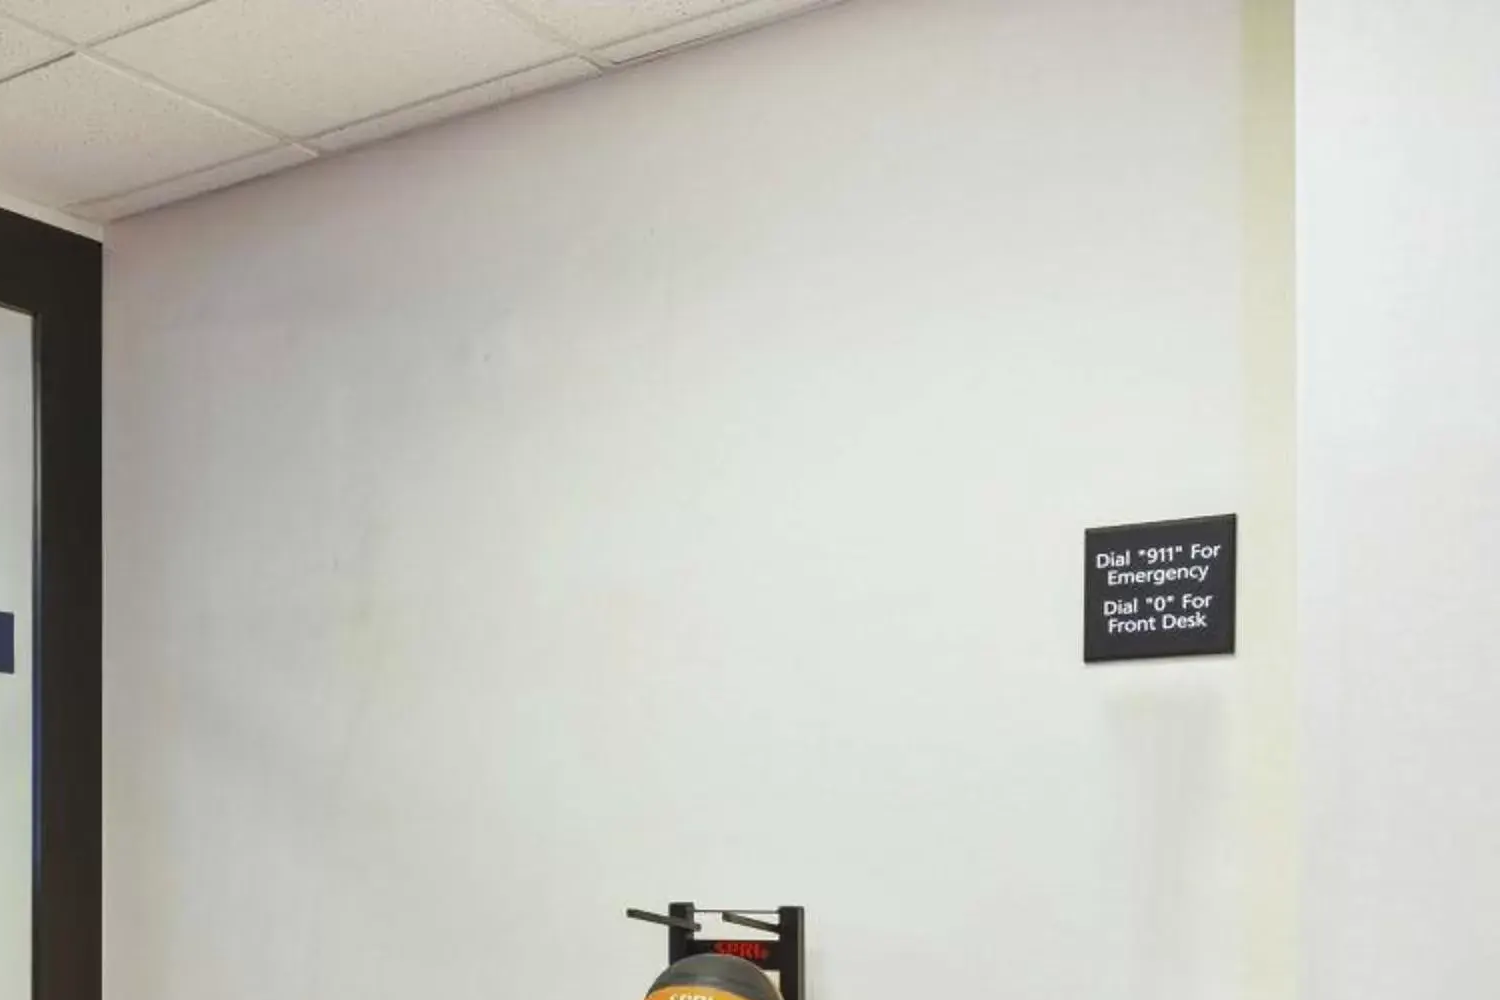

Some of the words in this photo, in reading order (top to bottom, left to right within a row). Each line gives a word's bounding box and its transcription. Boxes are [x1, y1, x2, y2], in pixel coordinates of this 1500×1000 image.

[1096, 550, 1131, 568] Dial
[1138, 545, 1182, 564] "911"
[1191, 543, 1221, 560] For
[1107, 565, 1209, 586] Emergency
[1103, 597, 1138, 616] Dial
[1182, 594, 1213, 609] For
[1107, 617, 1156, 633] Front
[1162, 612, 1208, 629] Desk
